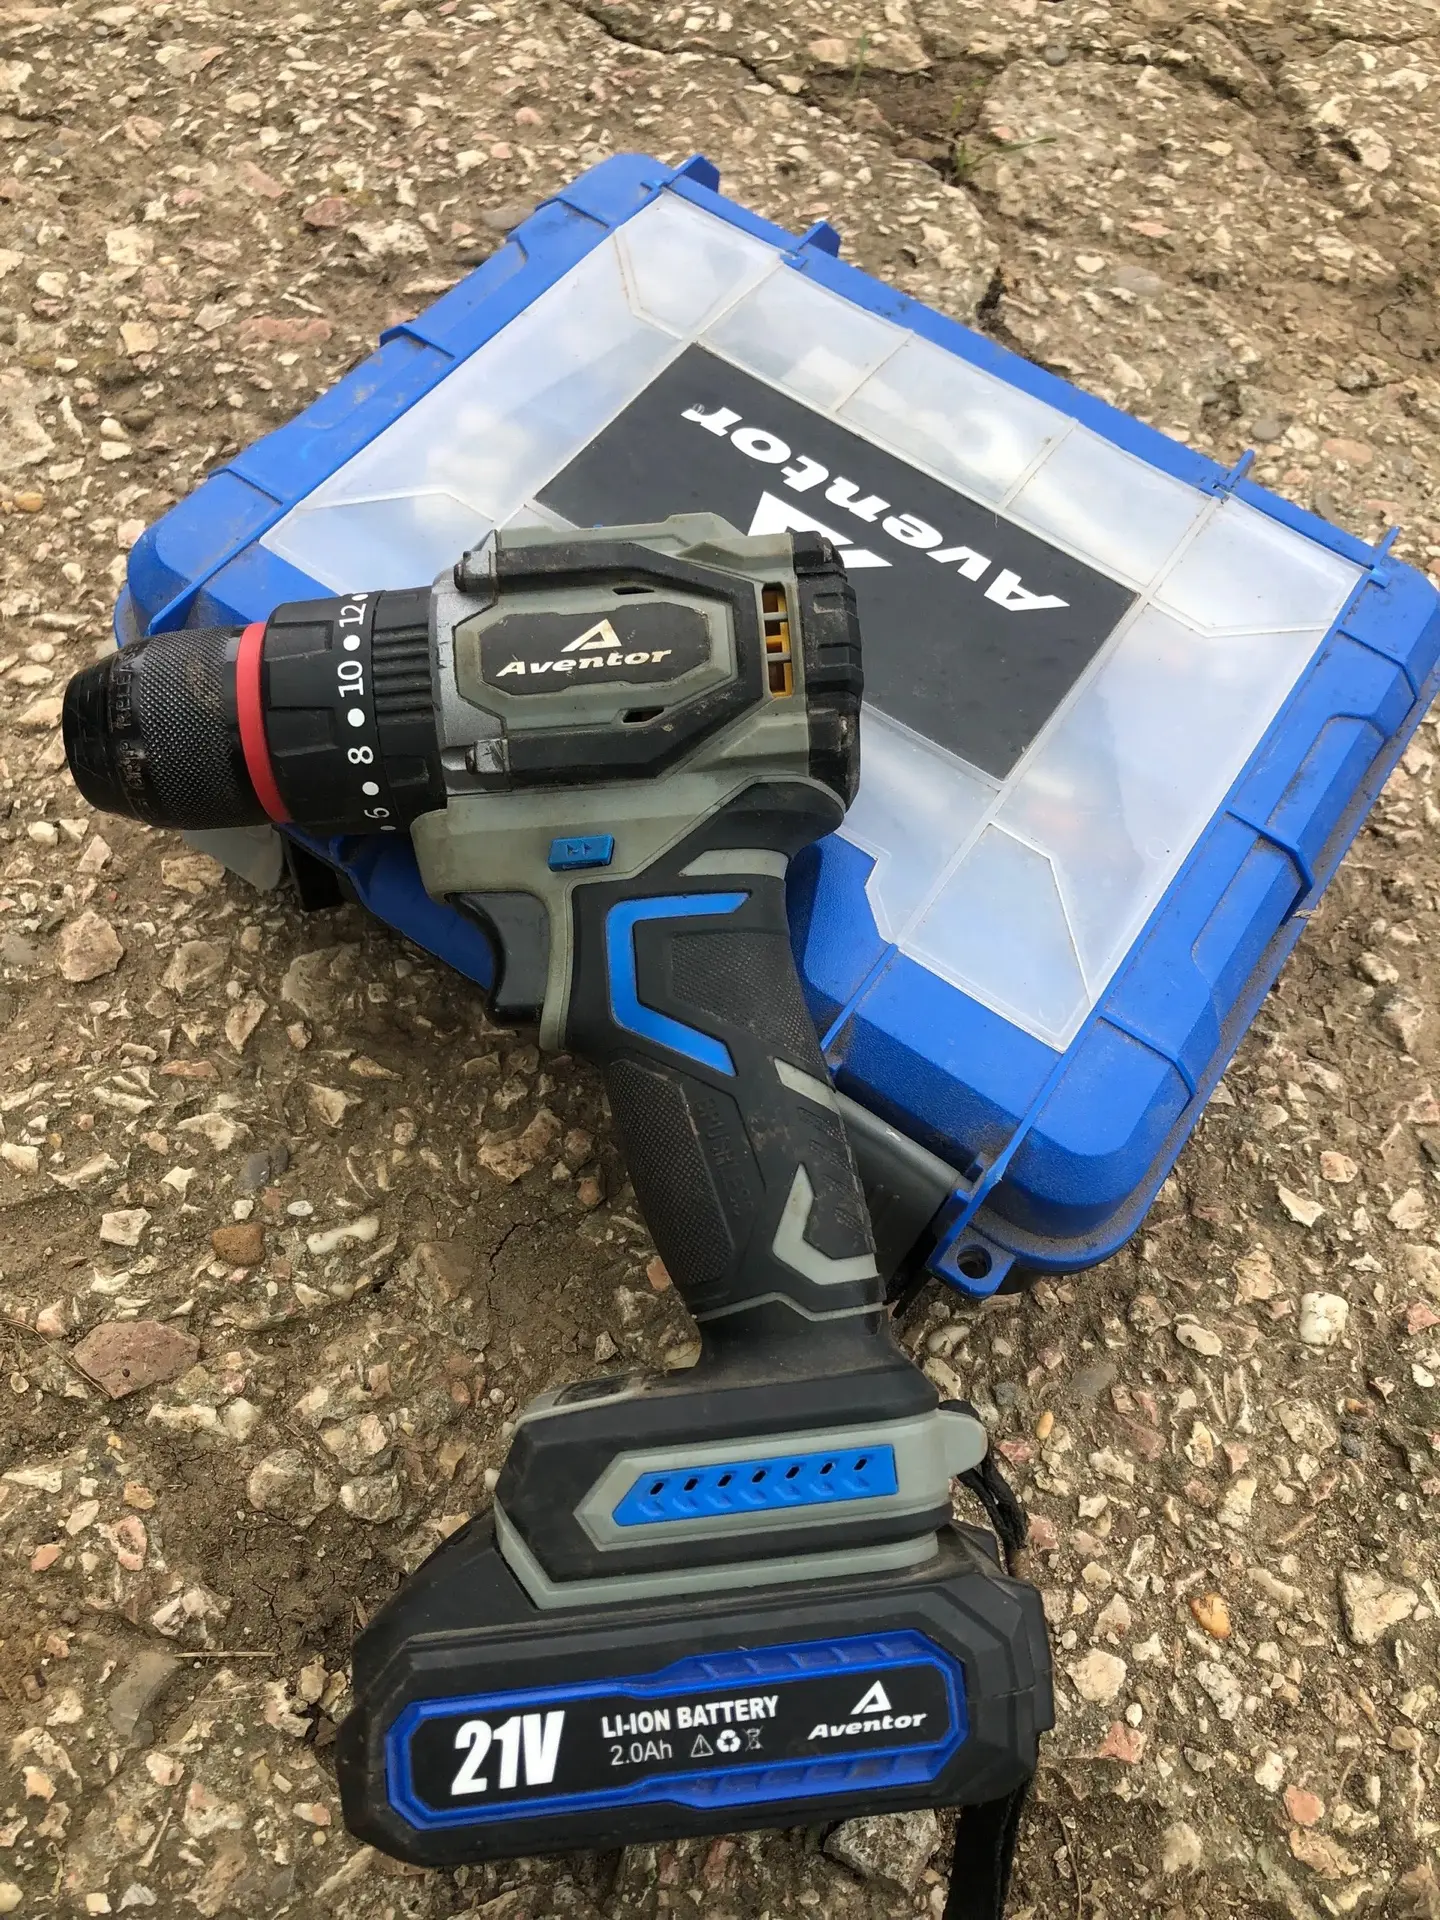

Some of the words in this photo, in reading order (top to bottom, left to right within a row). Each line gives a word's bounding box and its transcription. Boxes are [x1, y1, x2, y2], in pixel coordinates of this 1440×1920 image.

[680, 404, 1070, 611] Aventor
[338, 603, 367, 628] 12
[496, 647, 672, 677] Aventor
[337, 660, 363, 697] 10
[347, 745, 374, 765] 8
[364, 807, 390, 819] 6
[602, 1709, 670, 1739] LI-ION
[677, 1695, 779, 1729] BATTERY
[808, 1713, 928, 1740] Aventor
[450, 1710, 565, 1796] 21V
[611, 1739, 673, 1766] 2.0Ah
